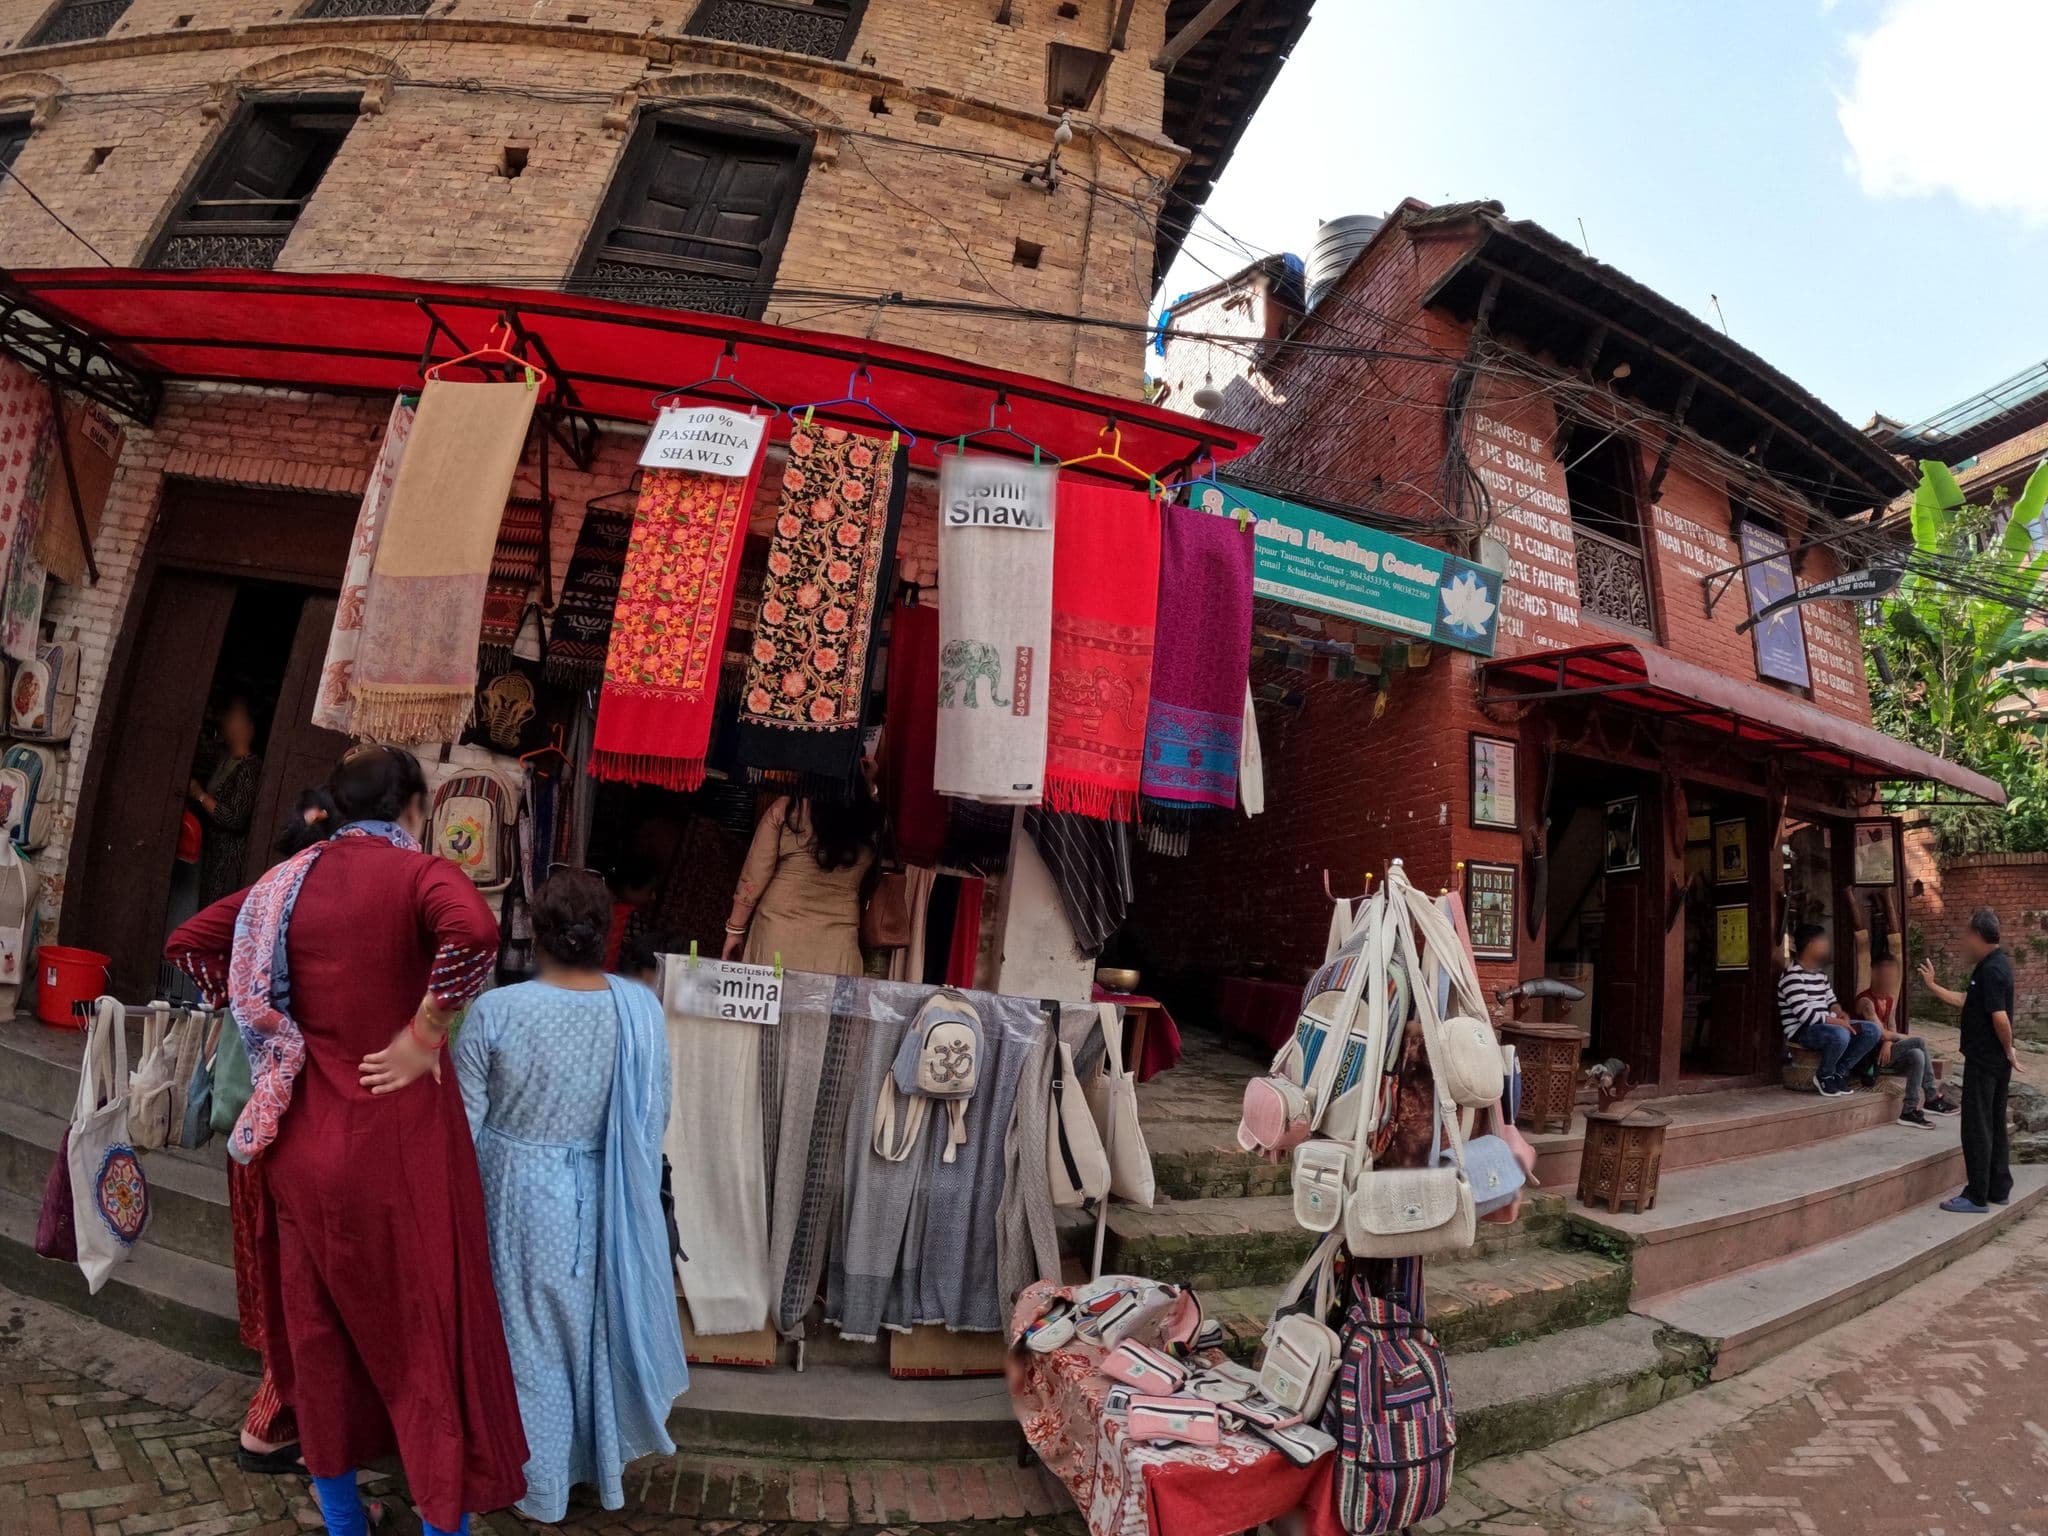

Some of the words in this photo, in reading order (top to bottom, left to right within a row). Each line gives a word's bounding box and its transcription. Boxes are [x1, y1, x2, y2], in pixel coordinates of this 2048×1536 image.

[688, 413, 714, 424] 100
[719, 414, 733, 428] %
[658, 429, 749, 450] PASHMINA
[1476, 438, 1503, 464] THE
[1530, 436, 1543, 454] OF
[660, 447, 735, 467] SHAWLS
[1480, 466, 1513, 494] MOST
[1516, 481, 1568, 515] GENEROUS
[1497, 499, 1549, 534] GENEROUS
[1652, 504, 1663, 525] IT
[1663, 510, 1674, 528] IS
[1703, 528, 1716, 547] TO
[1307, 529, 1379, 572] Healing
[1382, 552, 1440, 587] Center
[1514, 532, 1525, 552] A
[1525, 537, 1574, 569] COUNTRY
[1655, 528, 1682, 554] THAN
[1681, 540, 1694, 559] TO
[1694, 546, 1707, 565] BE
[1706, 552, 1714, 568] A
[1260, 559, 1281, 570] email
[1318, 560, 1345, 576] Contact
[1508, 558, 1531, 583] ORE
[1532, 566, 1580, 599] FAITHFUL
[1797, 580, 1836, 598] EX-GURKHA
[1837, 573, 1869, 586] KHUKURI
[1829, 583, 1851, 595] SHOW
[1853, 580, 1876, 590] ROOM
[1500, 585, 1548, 617] FRIENDS
[1550, 600, 1579, 628] THAN
